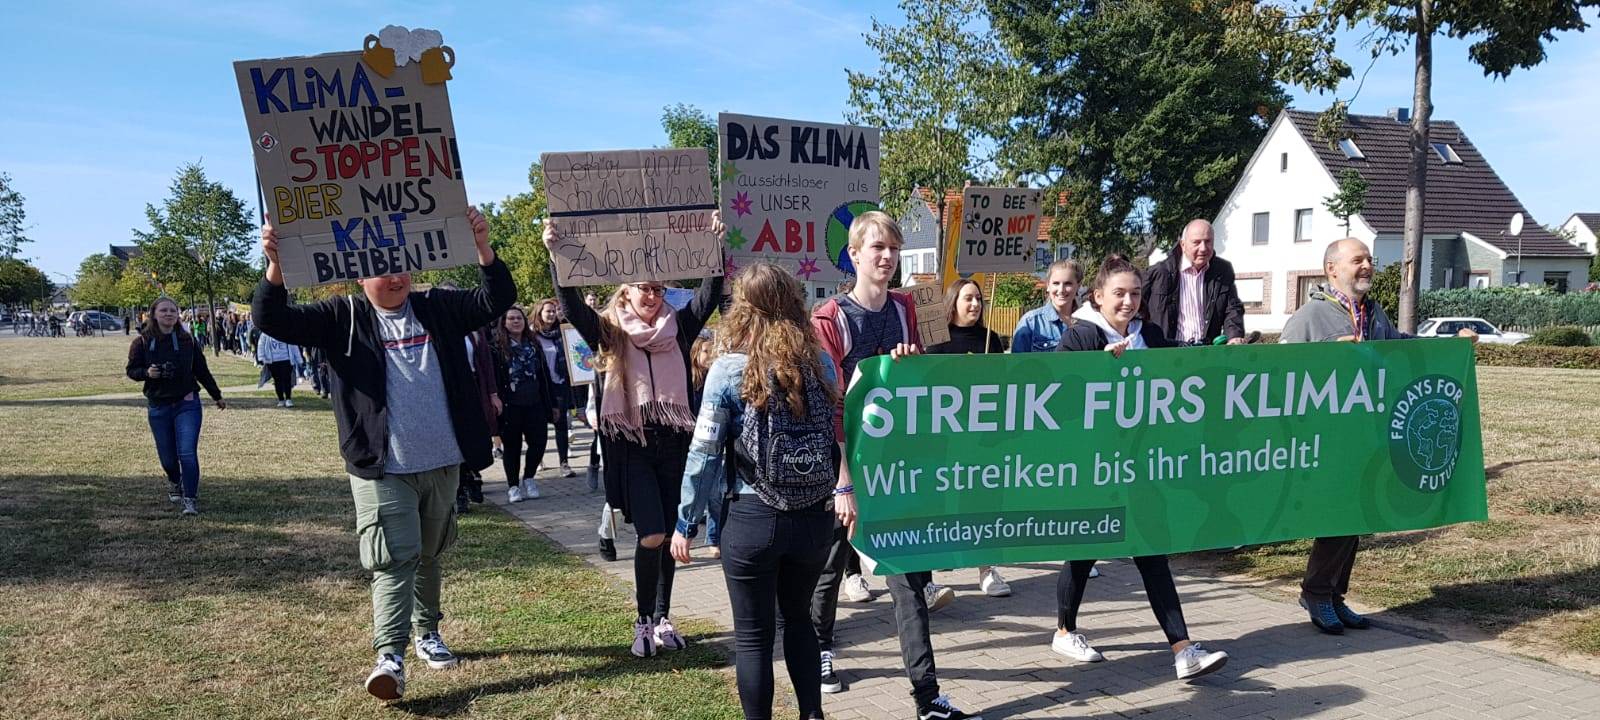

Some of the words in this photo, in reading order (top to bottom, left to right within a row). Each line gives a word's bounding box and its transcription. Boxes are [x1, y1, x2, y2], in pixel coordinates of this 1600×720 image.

[309, 103, 442, 145] WANDEL
[290, 136, 463, 182] STOPPEN!
[642, 151, 700, 178] einen
[727, 122, 779, 160] DAS
[790, 126, 871, 171] KLIMA
[273, 182, 343, 225] BIER
[359, 178, 436, 215] MUSS
[737, 173, 829, 190] aussichtsloser
[848, 180, 869, 193] als
[970, 194, 991, 209] TO
[1003, 194, 1027, 210] BEE
[760, 193, 812, 212] UNSER
[330, 212, 408, 252] KALT
[624, 211, 651, 236] ich
[667, 211, 707, 235] keine
[752, 218, 815, 253] ABI
[981, 217, 1004, 236] OR
[1007, 214, 1036, 235] NOT
[312, 230, 448, 283] BLEIBEN!!
[965, 240, 988, 257] TO
[993, 236, 1024, 257] BEE
[862, 382, 1063, 439] STREIK
[1083, 365, 1206, 431] FÜRS
[1224, 367, 1387, 421] KLIMA!
[1390, 378, 1433, 441] FRIDAYS
[1436, 378, 1463, 405] FOR
[862, 460, 923, 498] Wir
[935, 454, 1078, 493] streiken
[1093, 450, 1137, 487] bis
[1148, 447, 1189, 482] ihr
[1200, 433, 1320, 477] handelt!
[869, 514, 1122, 550] www.fridaysforfuture.de
